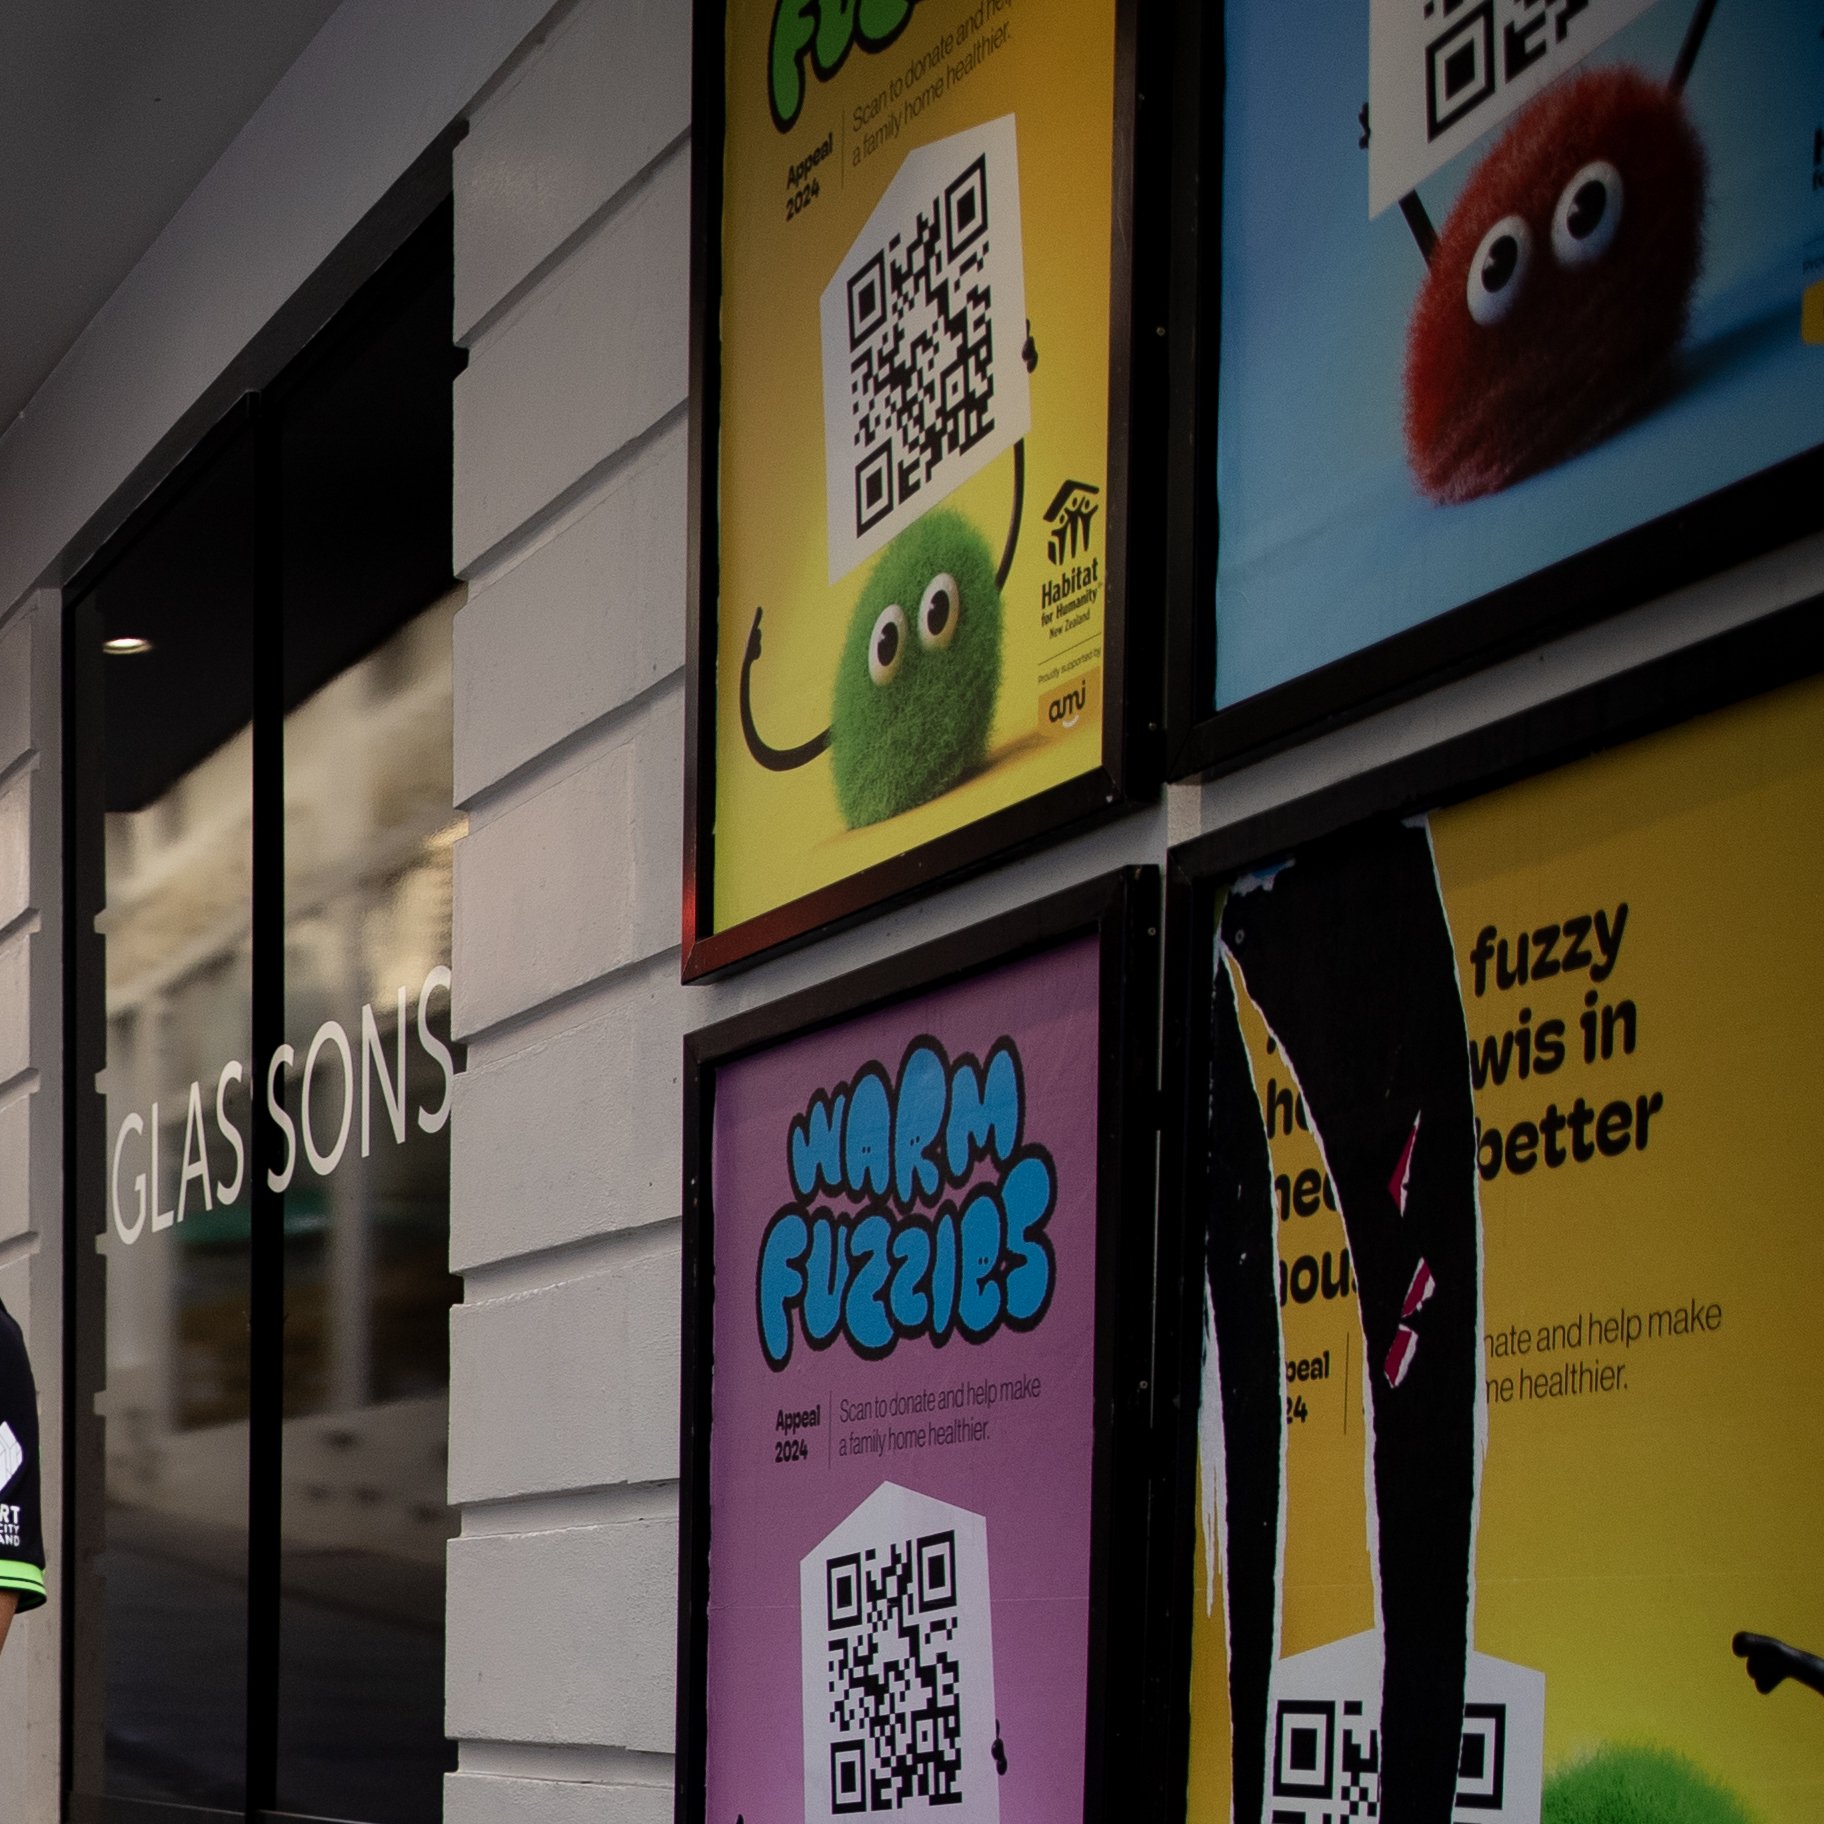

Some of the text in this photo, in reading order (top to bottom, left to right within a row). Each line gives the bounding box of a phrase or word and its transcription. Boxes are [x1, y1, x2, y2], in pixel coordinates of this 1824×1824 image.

[853, 90, 887, 133] Scan
[889, 78, 903, 102] to
[904, 32, 954, 88] donate
[956, 1, 984, 46] and
[852, 21, 1011, 167] a family home healthier.
[786, 131, 834, 190] Appeal
[786, 178, 821, 222] 2024
[1041, 558, 1099, 610] Habitat
[1041, 588, 1098, 627] for Humanity
[1048, 607, 1091, 640] New Zealand
[1048, 679, 1086, 724] ami
[1469, 902, 1629, 998] fuzzy
[1469, 1007, 1566, 1091] wis
[1580, 989, 1637, 1065] in
[787, 1034, 1026, 1213] WARM
[1474, 1091, 1663, 1182] better
[757, 1144, 1057, 1372] FUZZIES
[1536, 1312, 1583, 1352] and
[1588, 1307, 1642, 1348] help
[1648, 1298, 1722, 1338] make
[839, 1373, 1042, 1423] Scan to donate and help make
[1519, 1359, 1628, 1400] healthier.
[776, 1404, 821, 1435] Appeal
[839, 1418, 990, 1458] a family home healthier.
[775, 1438, 809, 1463] 2024
